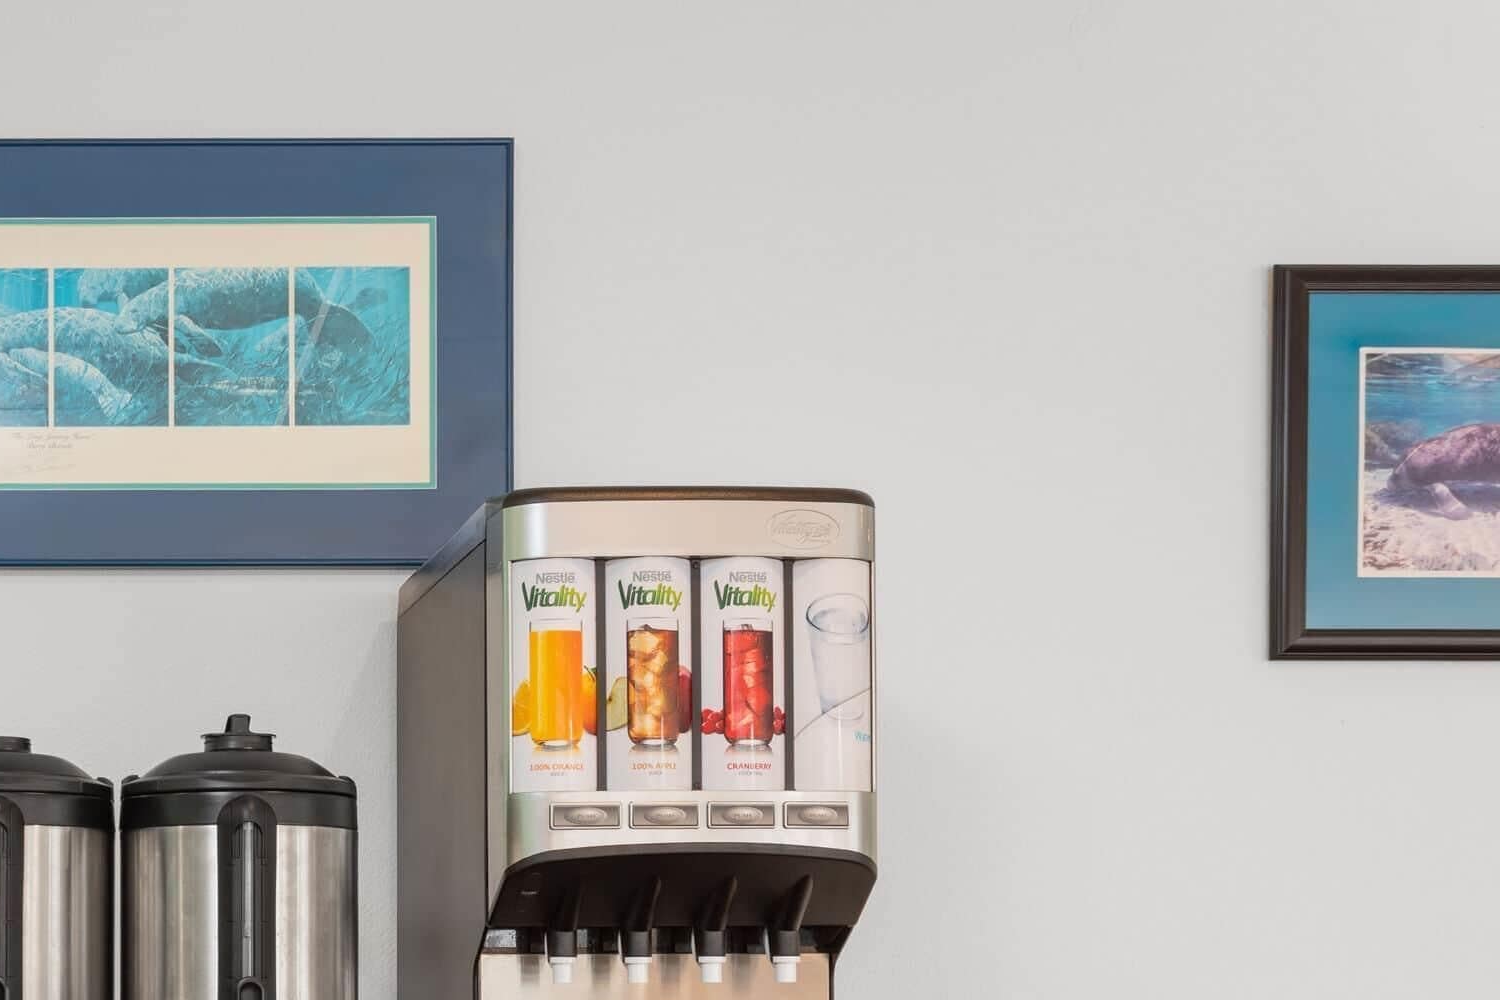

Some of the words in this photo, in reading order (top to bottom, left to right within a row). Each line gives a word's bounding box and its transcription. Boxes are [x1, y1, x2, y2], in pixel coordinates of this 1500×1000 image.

[522, 580, 587, 613] Vitality
[618, 579, 683, 612] Vitality
[714, 579, 778, 613] Vitality
[727, 762, 772, 770] CRANBERRY
